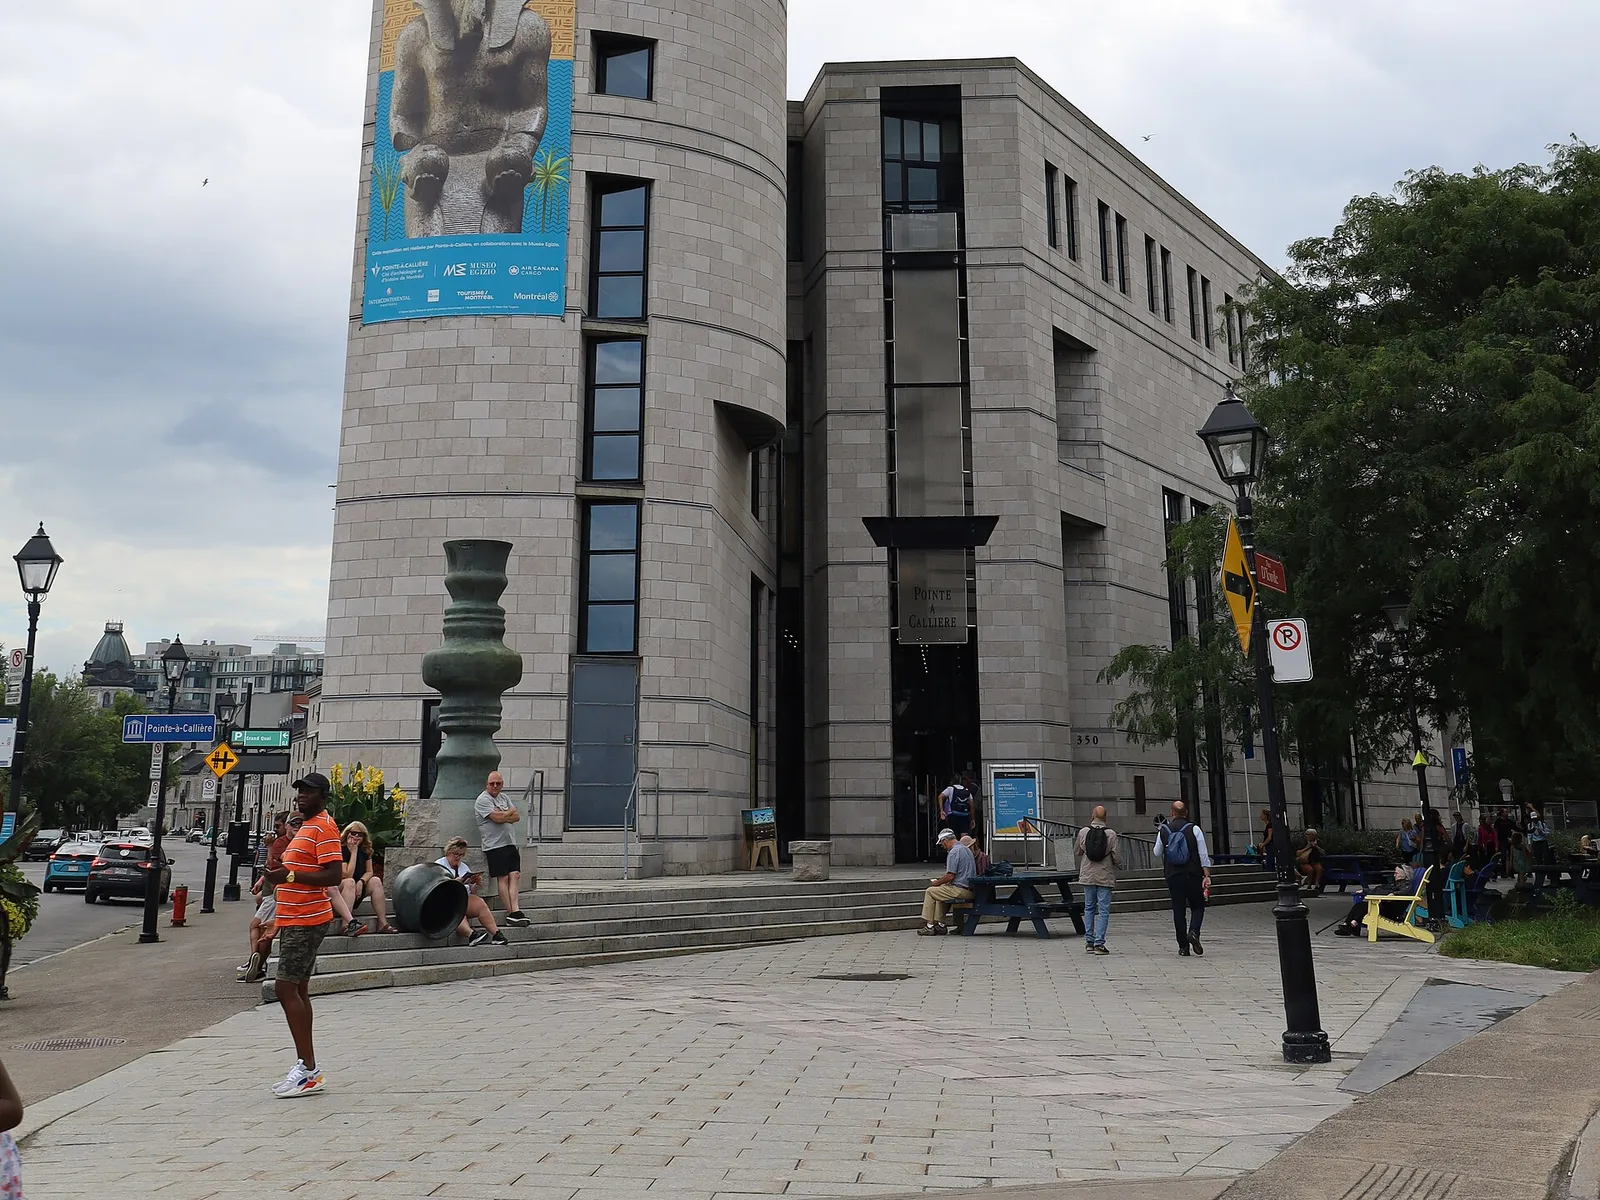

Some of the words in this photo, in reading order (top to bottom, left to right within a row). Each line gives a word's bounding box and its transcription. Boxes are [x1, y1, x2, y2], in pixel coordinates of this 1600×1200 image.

[469, 261, 497, 269] MUSEO
[469, 268, 497, 276] EGIZIO
[513, 292, 548, 301] Montréal
[147, 723, 213, 734] Pointe-à-Callière
[260, 734, 272, 742] Quai
[1076, 734, 1099, 745] 350
